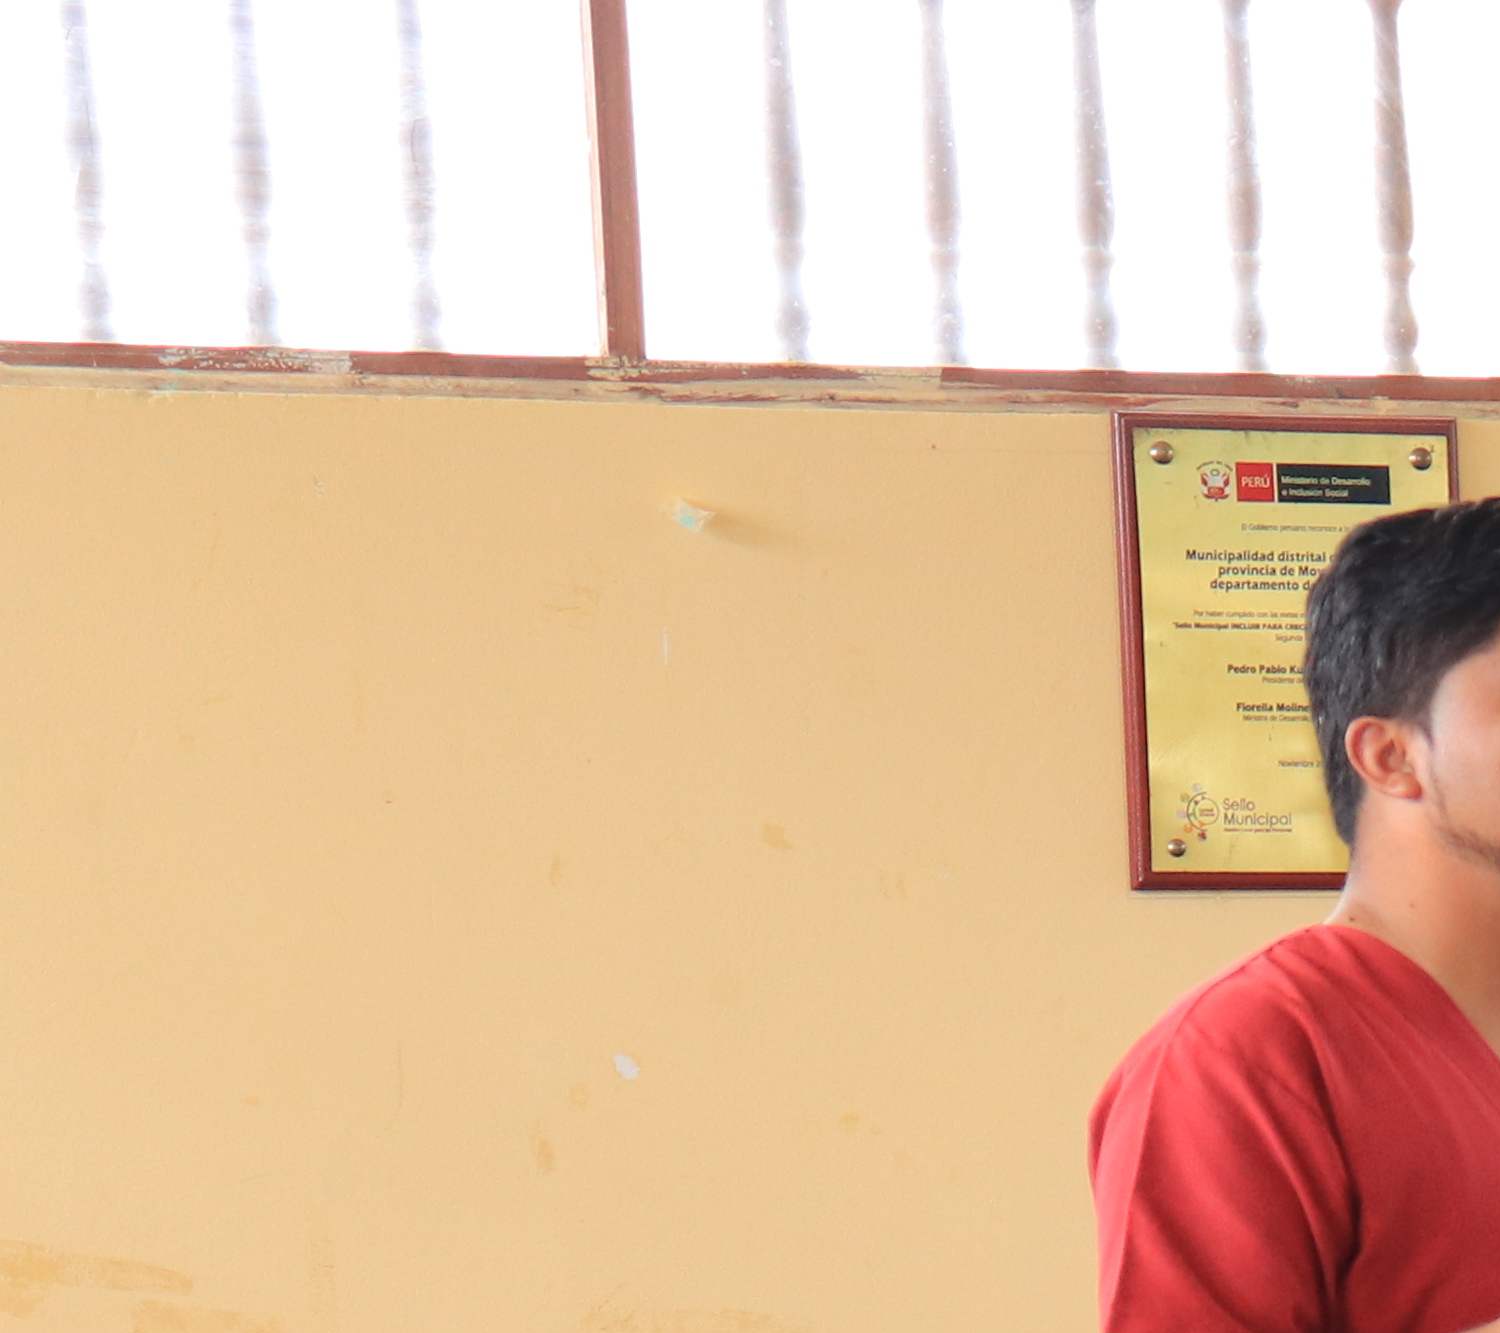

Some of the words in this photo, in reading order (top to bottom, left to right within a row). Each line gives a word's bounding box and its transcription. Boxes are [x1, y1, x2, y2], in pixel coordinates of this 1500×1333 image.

[1241, 474, 1270, 488] PERÚ
[1281, 476, 1318, 485] Ministerio
[1320, 477, 1330, 485] de
[1332, 477, 1371, 486] Desarrollo
[1289, 488, 1323, 497] Inclusión
[1325, 489, 1349, 498] Social
[1185, 549, 1274, 563] Municipalidad
[1278, 551, 1326, 563] distrital
[1218, 565, 1276, 579] provincia
[1280, 566, 1295, 576] de
[1210, 580, 1299, 593] departamento
[1227, 664, 1256, 674] Pedro
[1259, 665, 1287, 674] Pablo
[1236, 703, 1273, 712] Fiorella
[1223, 797, 1255, 811] Sello
[1223, 813, 1292, 828] Municipal
